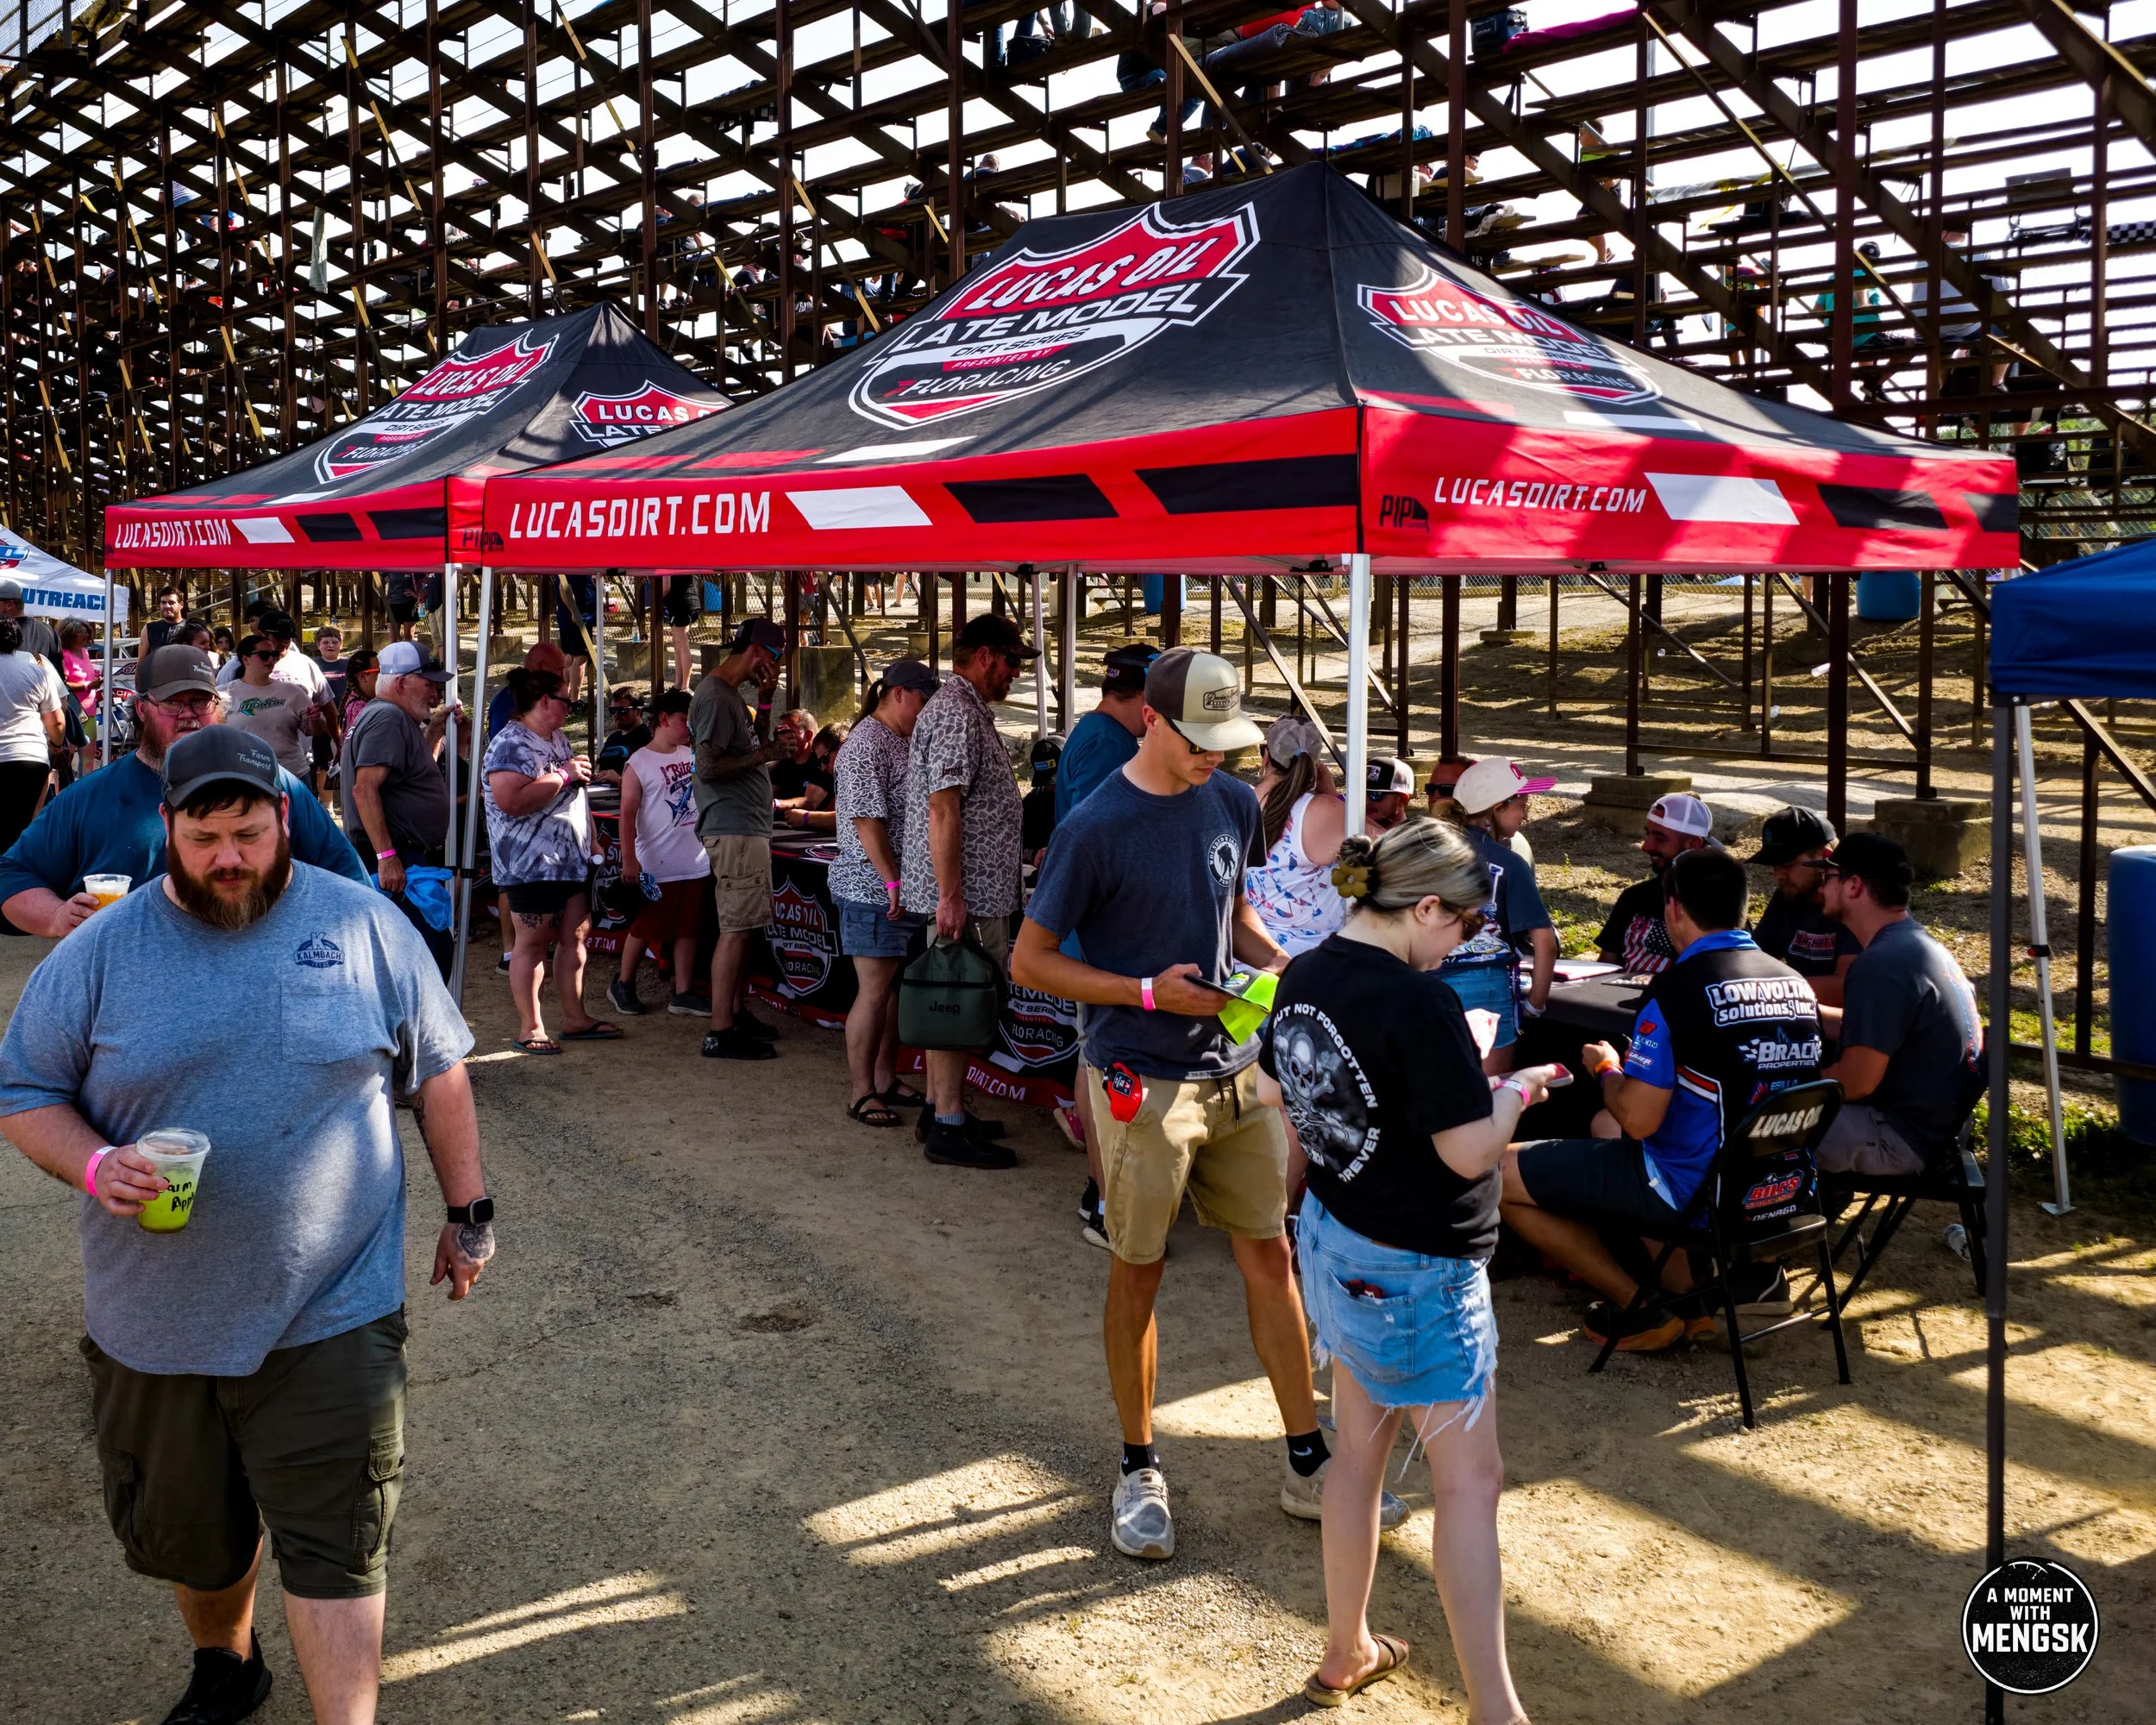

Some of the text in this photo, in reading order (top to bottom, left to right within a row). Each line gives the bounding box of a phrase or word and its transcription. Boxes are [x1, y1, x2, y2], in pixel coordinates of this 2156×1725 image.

[963, 237, 1224, 310] LUCAS OIL
[891, 283, 1203, 353] LATE MODEL
[1389, 298, 1564, 336] LUCAS OIL
[950, 328, 1090, 358] DIRT SERIES
[1390, 324, 1630, 365] LATE MODEL
[951, 348, 1052, 369] PRESENTED BY
[411, 356, 535, 397] LUCAS OIL
[899, 359, 1070, 396] FLORACING
[1514, 367, 1636, 389] FLORACING
[425, 389, 501, 418] MODEL
[598, 405, 690, 422] LUCAS
[582, 425, 662, 437] LATE
[1434, 477, 1647, 513] LUCASDIRT.COM
[510, 491, 770, 539] LUCASDIRT.COM
[1380, 495, 1413, 529] PIP
[115, 518, 231, 549] LUCASDIRT.COM
[22, 587, 105, 611] UTREAC
[237, 752, 272, 770] Transport
[250, 749, 270, 762] Farm
[776, 903, 801, 923] UCAS
[310, 932, 327, 950] K
[297, 950, 342, 961] KALMBACH
[1021, 985, 1075, 1013] MODE
[1711, 980, 1815, 1006] LOW VOLTA
[930, 1000, 961, 1016] Jeep
[1294, 1003, 1317, 1018] NOT
[1316, 1010, 1378, 1109] FORGOTTEN
[1758, 1040, 1819, 1063] BRACK
[1758, 1059, 1815, 1070] PROPERTIES
[1747, 1104, 1824, 1138] LUCAS OIL
[1338, 1126, 1381, 1183] OREVER
[1752, 1204, 1796, 1222] DENAGO
